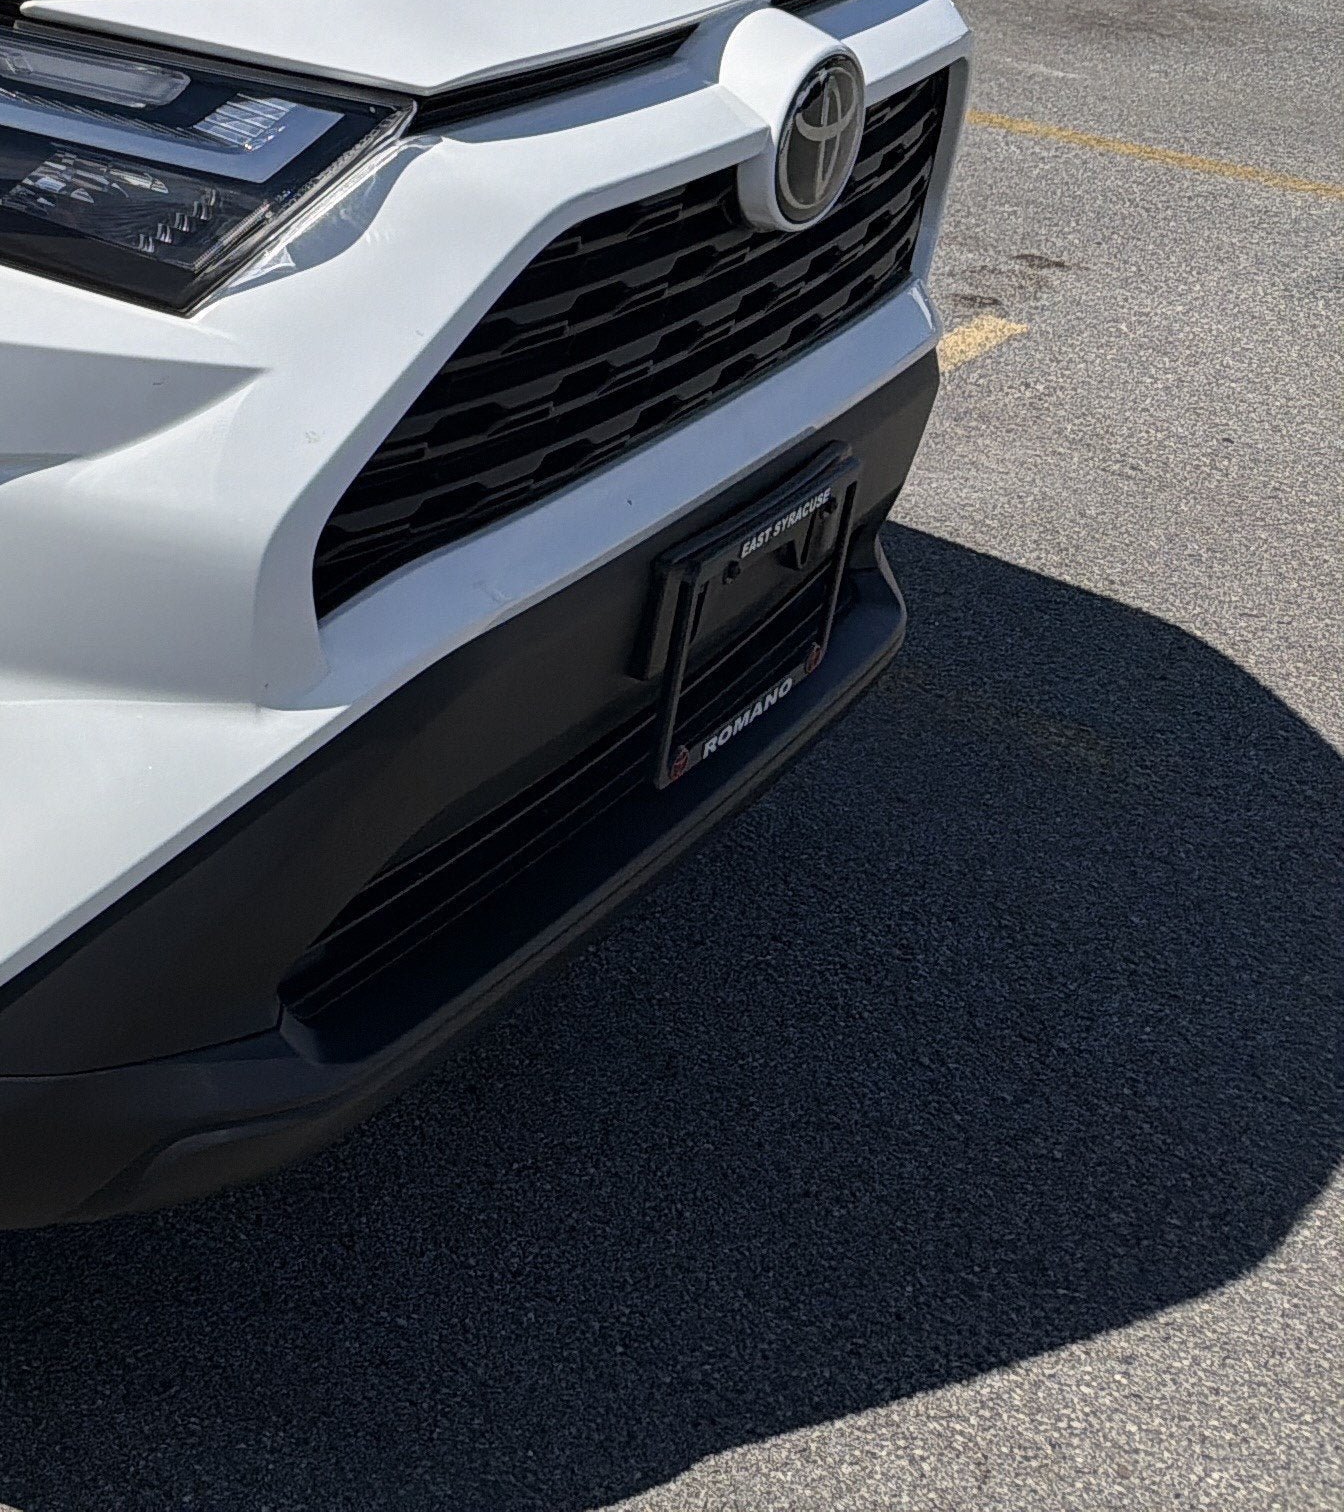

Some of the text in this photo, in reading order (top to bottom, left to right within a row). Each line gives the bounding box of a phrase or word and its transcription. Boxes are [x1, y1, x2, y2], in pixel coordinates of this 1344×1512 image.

[741, 486, 833, 559] EAST SYRACUSE
[702, 678, 793, 760] ROMANO
